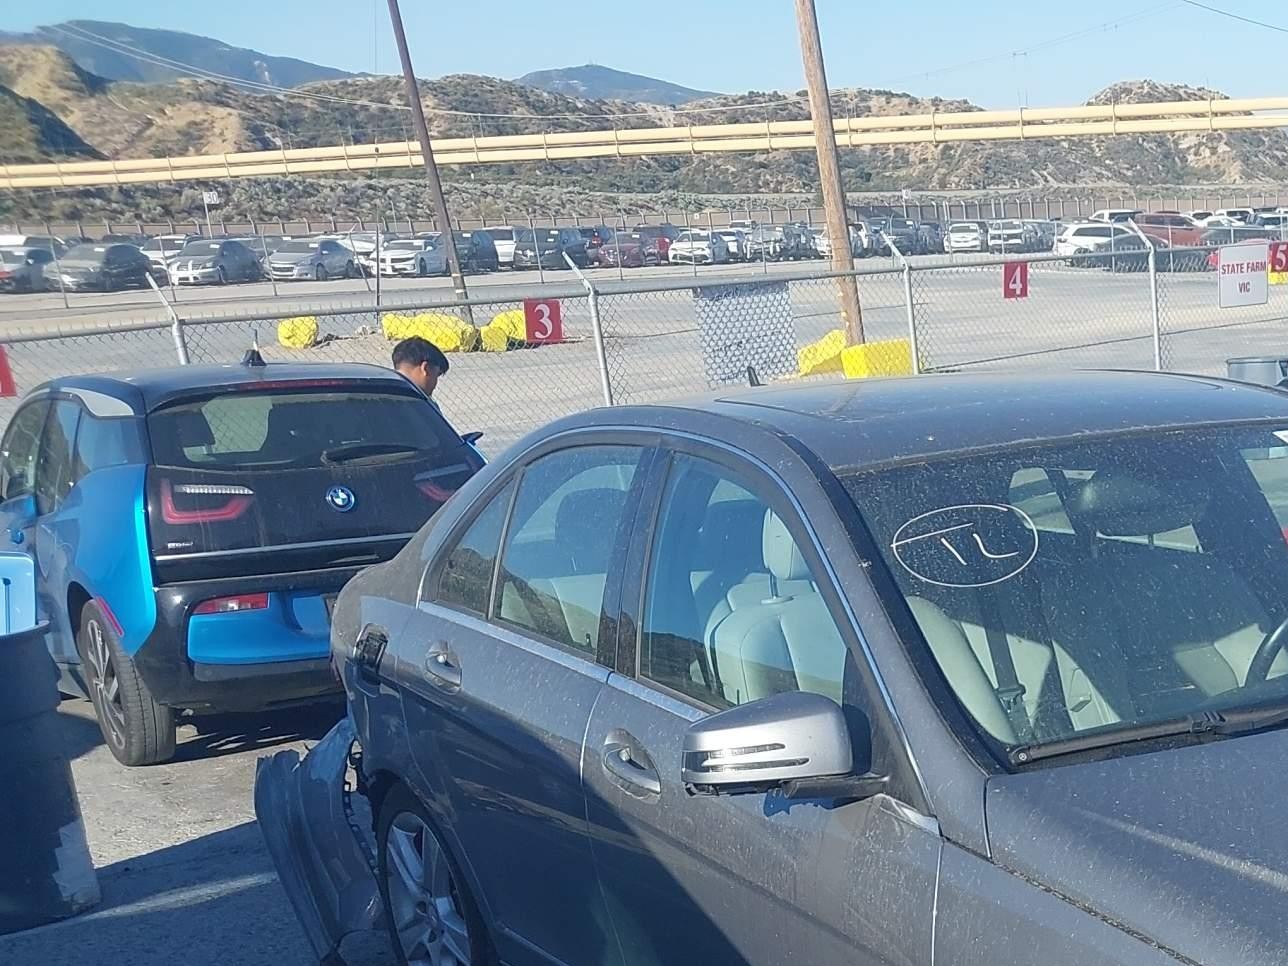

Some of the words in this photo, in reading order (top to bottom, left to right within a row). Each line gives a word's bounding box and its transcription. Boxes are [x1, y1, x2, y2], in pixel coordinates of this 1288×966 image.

[1221, 262, 1245, 275] STATE
[1246, 260, 1267, 274] FARM
[1274, 244, 1287, 271] 5
[1009, 265, 1023, 295] 4
[1238, 281, 1251, 294] VIC
[534, 303, 553, 339] 3
